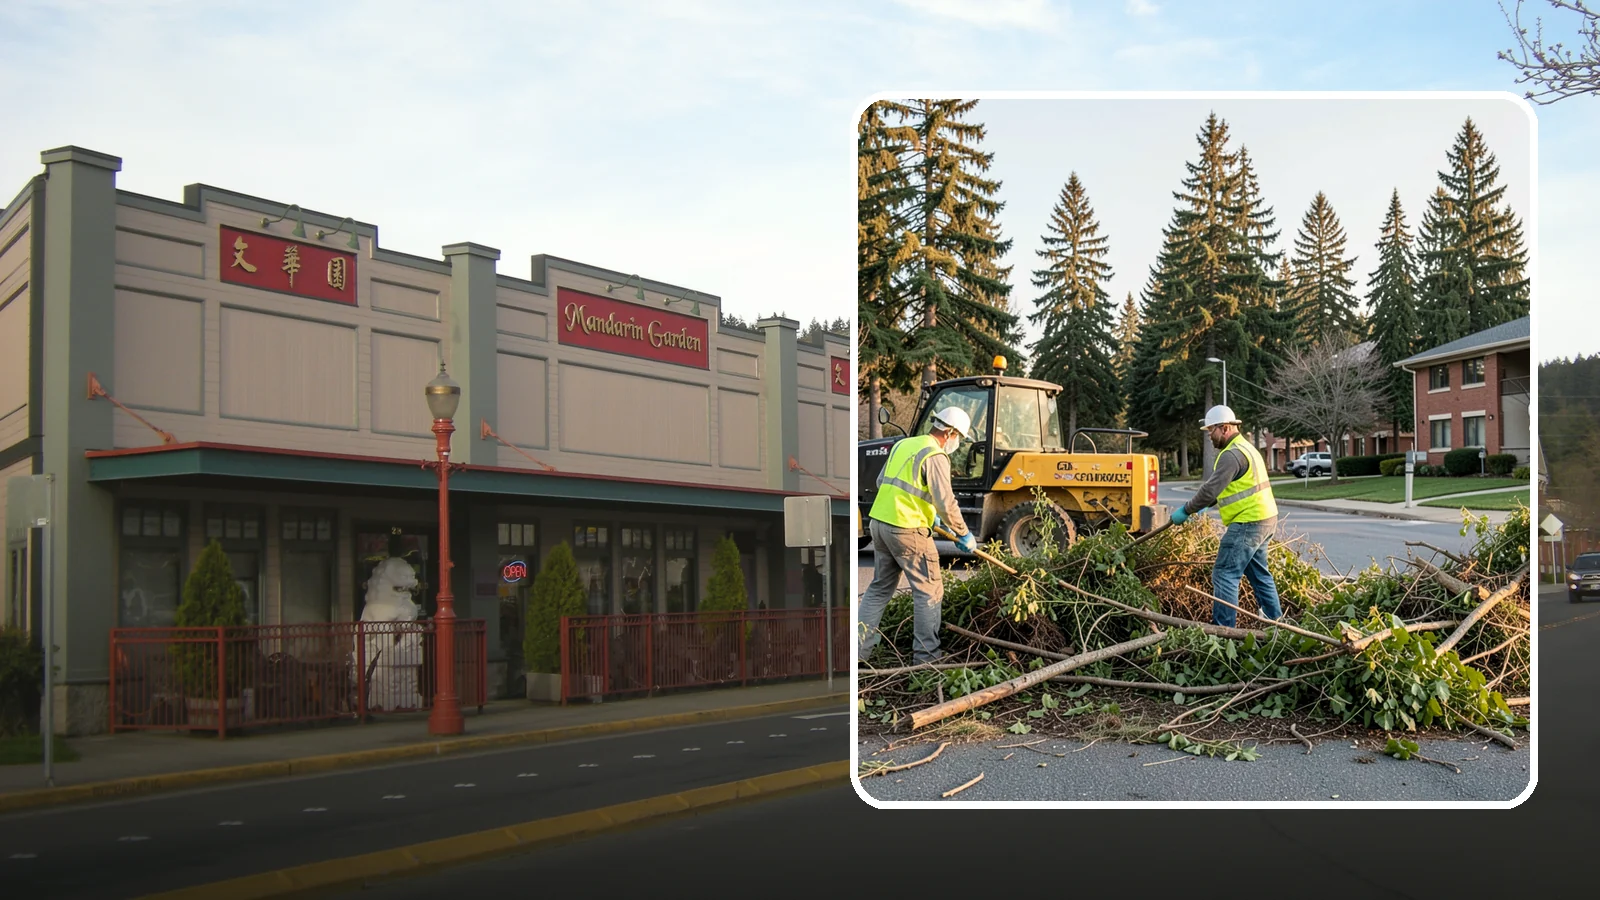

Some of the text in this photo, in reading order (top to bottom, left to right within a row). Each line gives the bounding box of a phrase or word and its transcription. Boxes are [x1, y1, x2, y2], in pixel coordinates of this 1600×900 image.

[230, 235, 346, 291] 文華園
[564, 302, 701, 352] Mandarin Garden
[503, 565, 527, 578] OPEN
